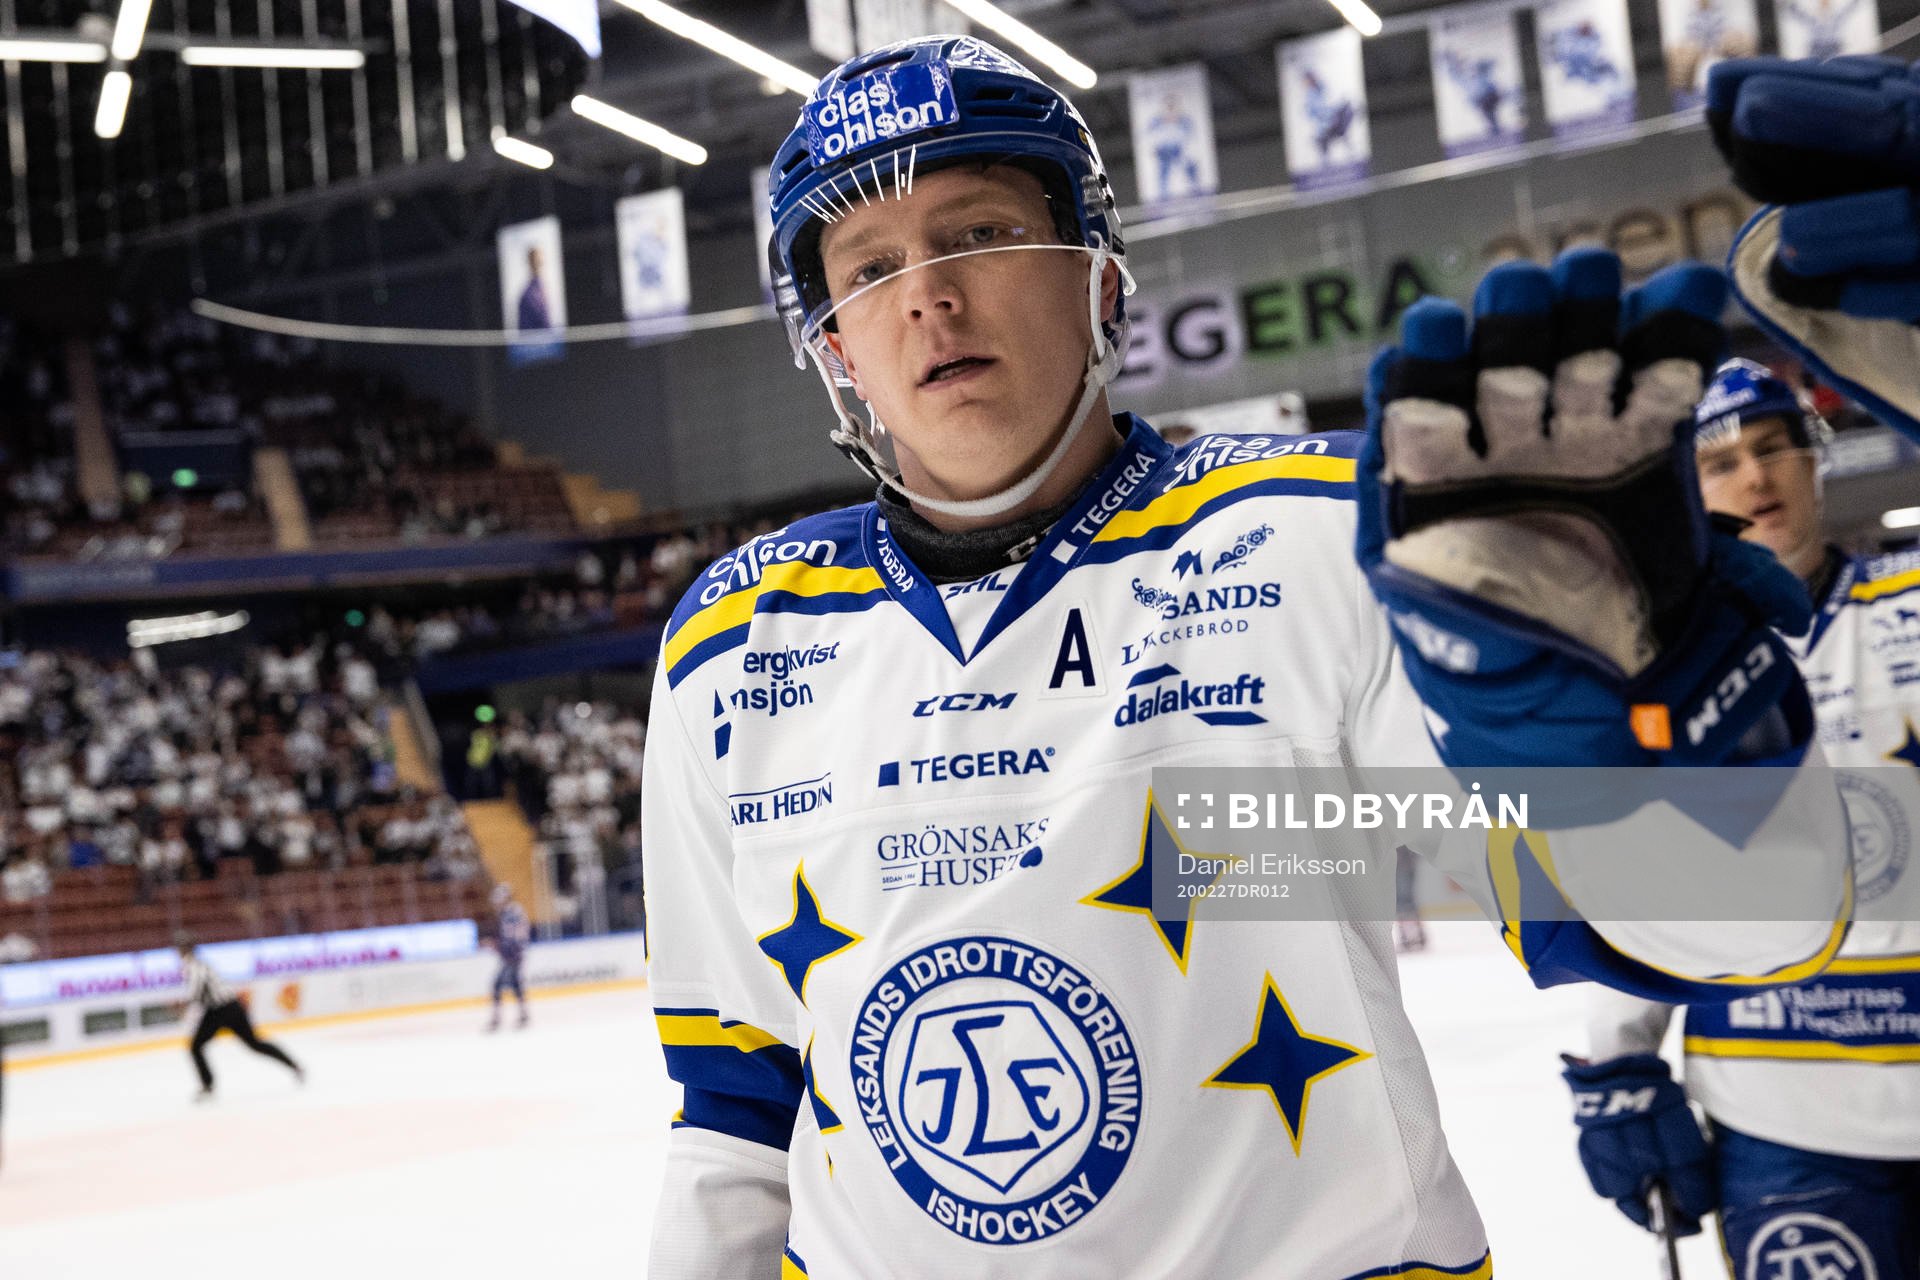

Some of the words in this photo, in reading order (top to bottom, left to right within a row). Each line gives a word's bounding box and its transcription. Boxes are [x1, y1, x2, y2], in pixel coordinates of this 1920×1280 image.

[818, 83, 890, 127] clas
[824, 100, 943, 157] ohlson
[1117, 257, 1430, 377] EGERA
[1070, 452, 1157, 535] TEGERA
[743, 641, 840, 680] ergkvist
[1047, 607, 1097, 690] A
[729, 680, 814, 716] nsjön
[1114, 674, 1265, 727] dalakraft
[731, 802, 768, 827] ARL
[877, 817, 1049, 862] GRÖNSAKS
[853, 980, 907, 1170] LEKSANDS
[899, 941, 1139, 1152] IDROTTSFÖRENING
[926, 1172, 1098, 1241] ISHOCKEY
